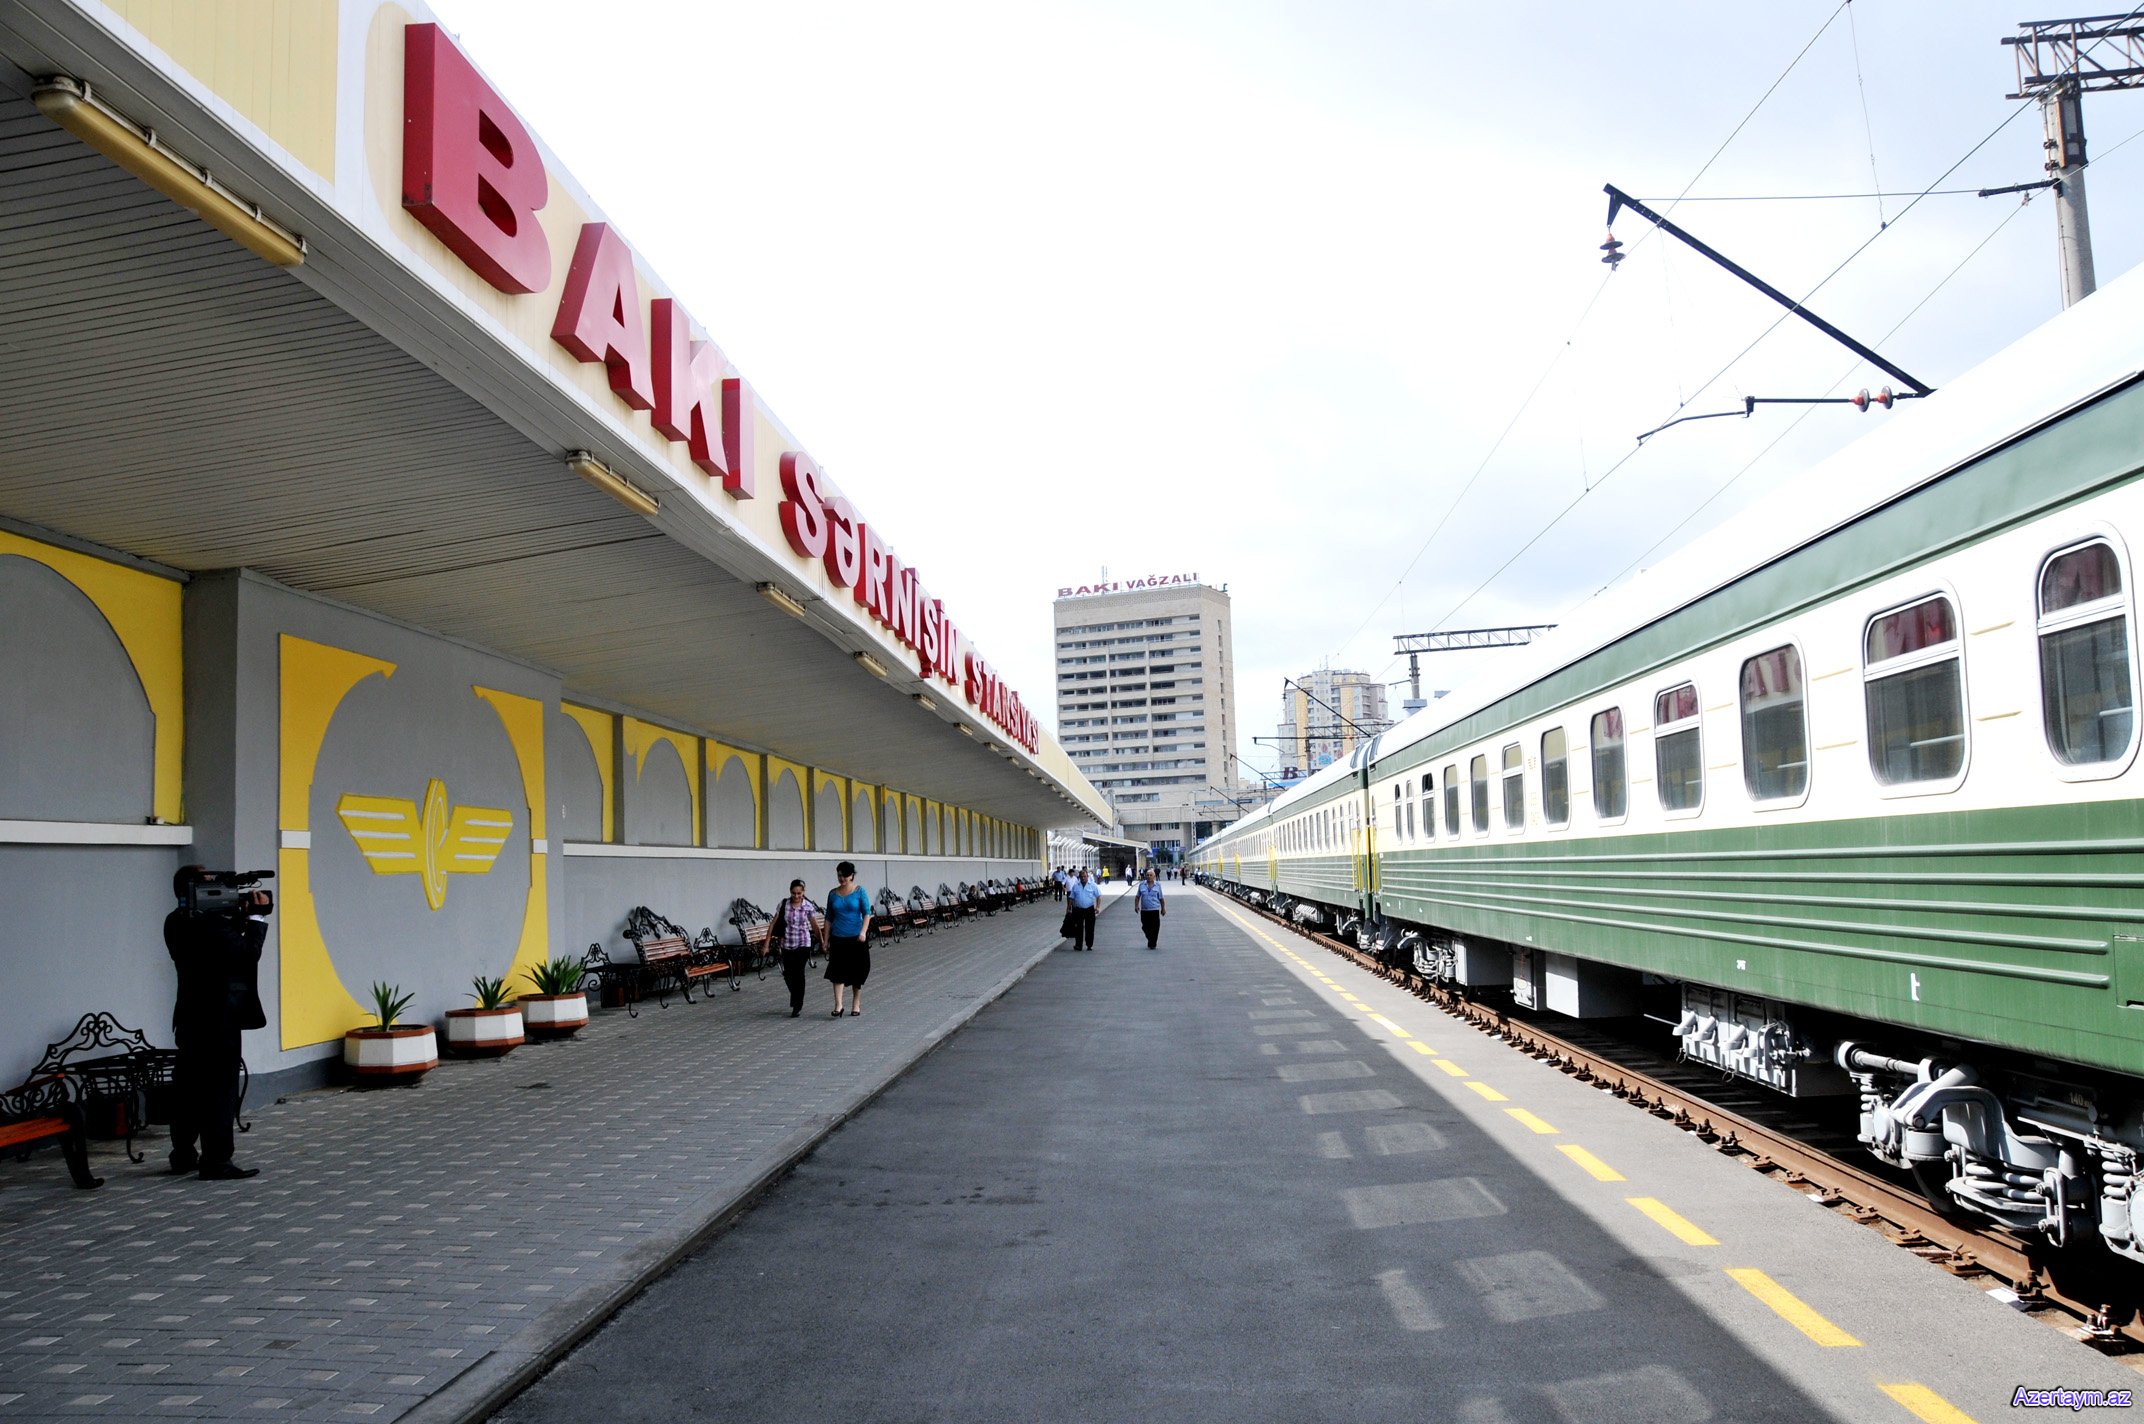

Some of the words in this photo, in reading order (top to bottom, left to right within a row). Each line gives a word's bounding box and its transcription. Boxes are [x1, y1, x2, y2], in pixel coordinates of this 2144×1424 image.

[402, 22, 755, 501] BAKI
[778, 450, 960, 686] SƏRNİŞİN
[964, 651, 1040, 755] STANSİYASI
[1057, 582, 1119, 598] BAKI
[1125, 572, 1198, 589] VAĞZALI
